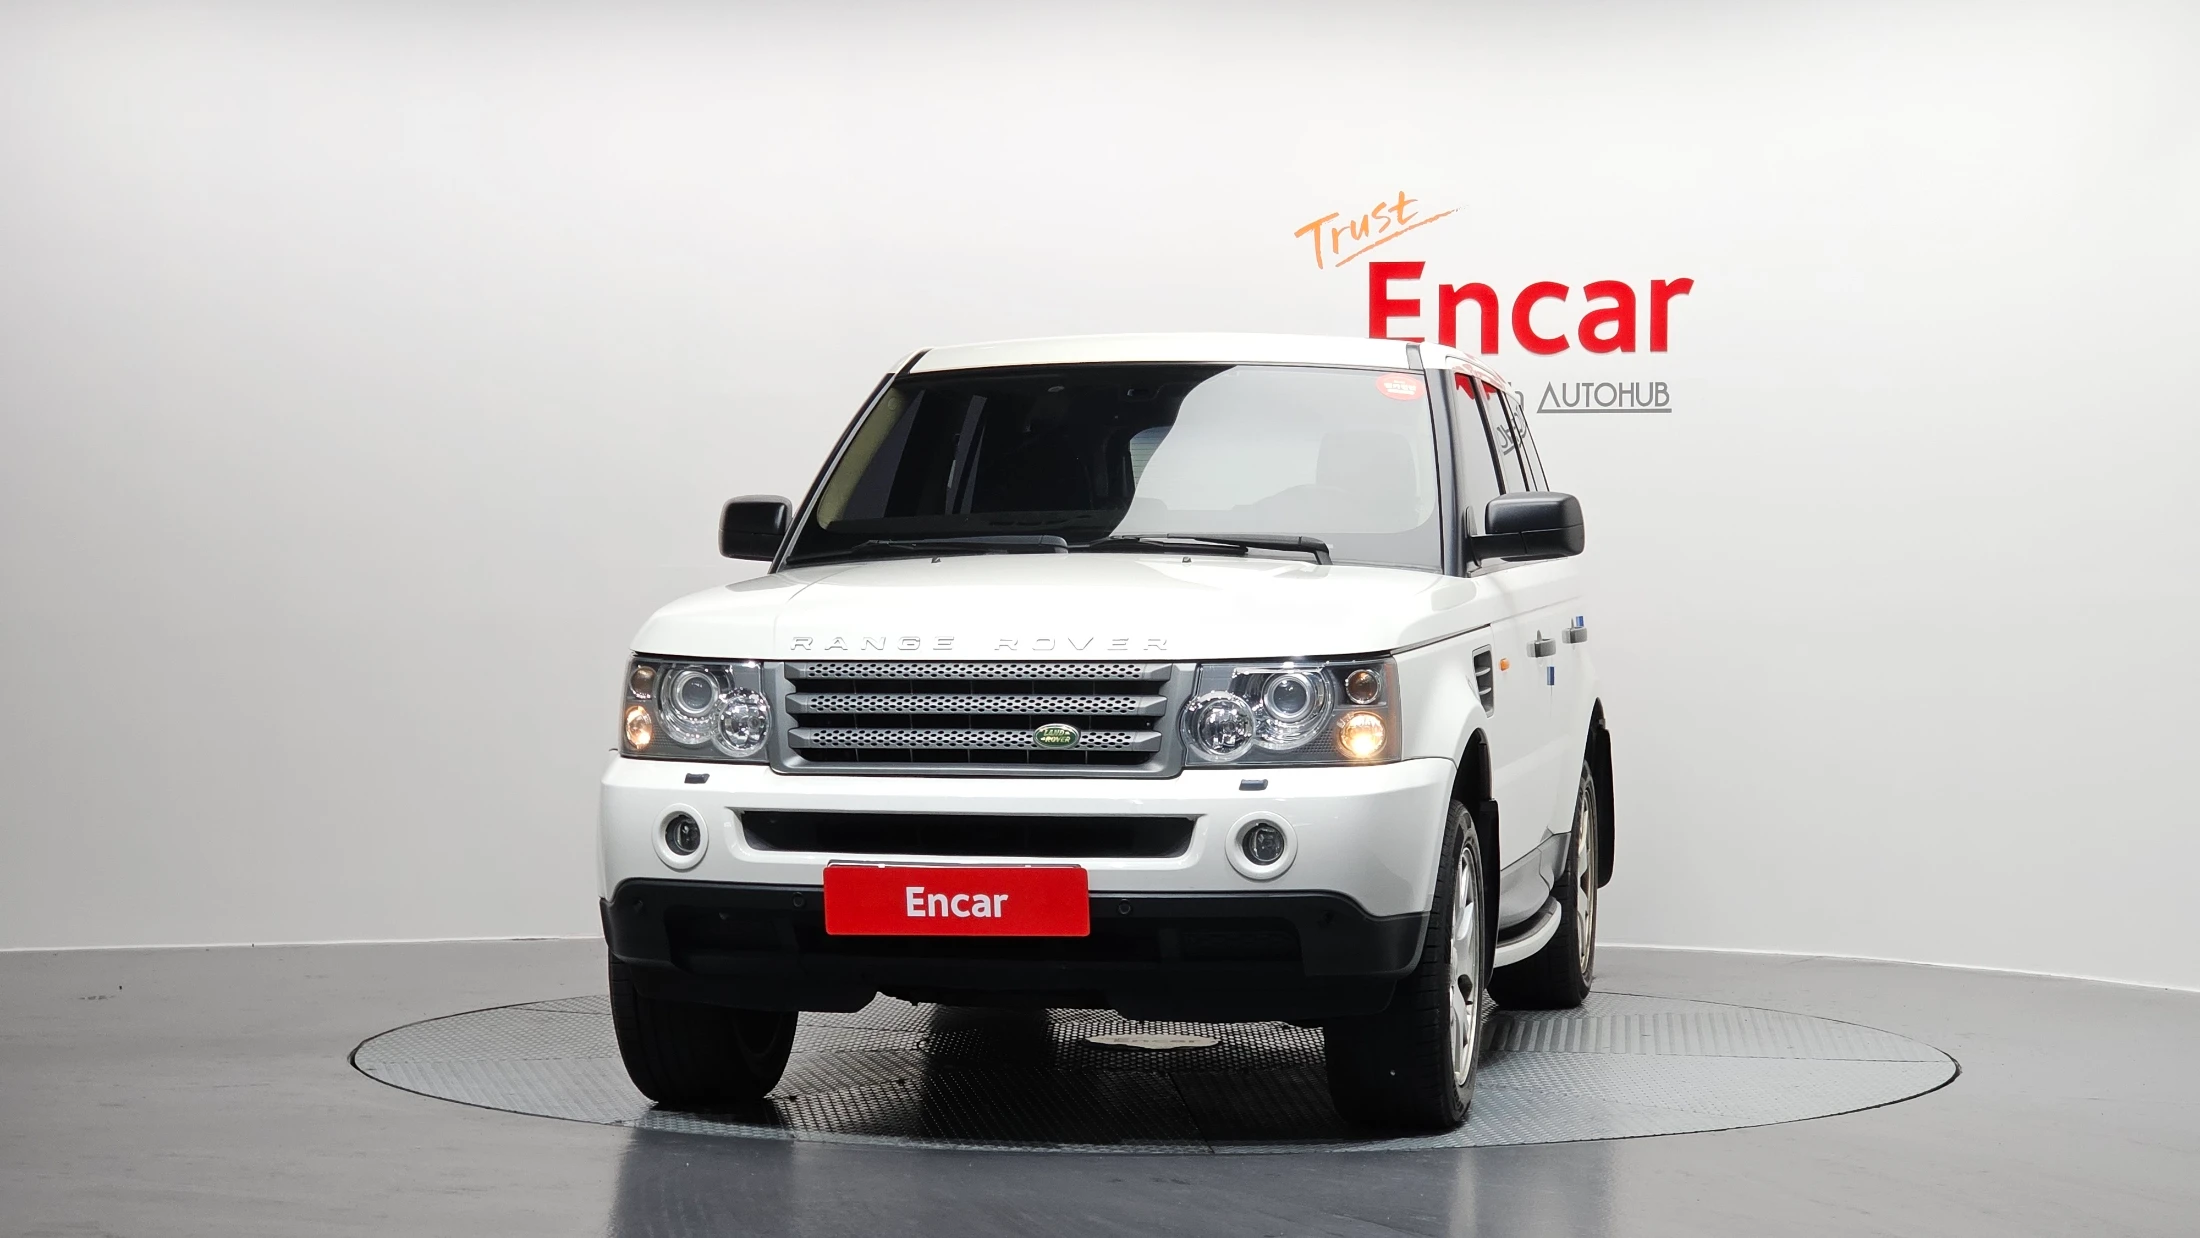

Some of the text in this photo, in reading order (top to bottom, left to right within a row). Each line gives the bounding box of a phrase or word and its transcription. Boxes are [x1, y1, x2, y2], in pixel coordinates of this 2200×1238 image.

[1294, 190, 1421, 269] Trust
[1368, 261, 1694, 355] Encar
[1537, 381, 1672, 412] AUTOHUB
[789, 636, 1168, 651] RANGE ROVER
[906, 886, 1008, 918] Encar
